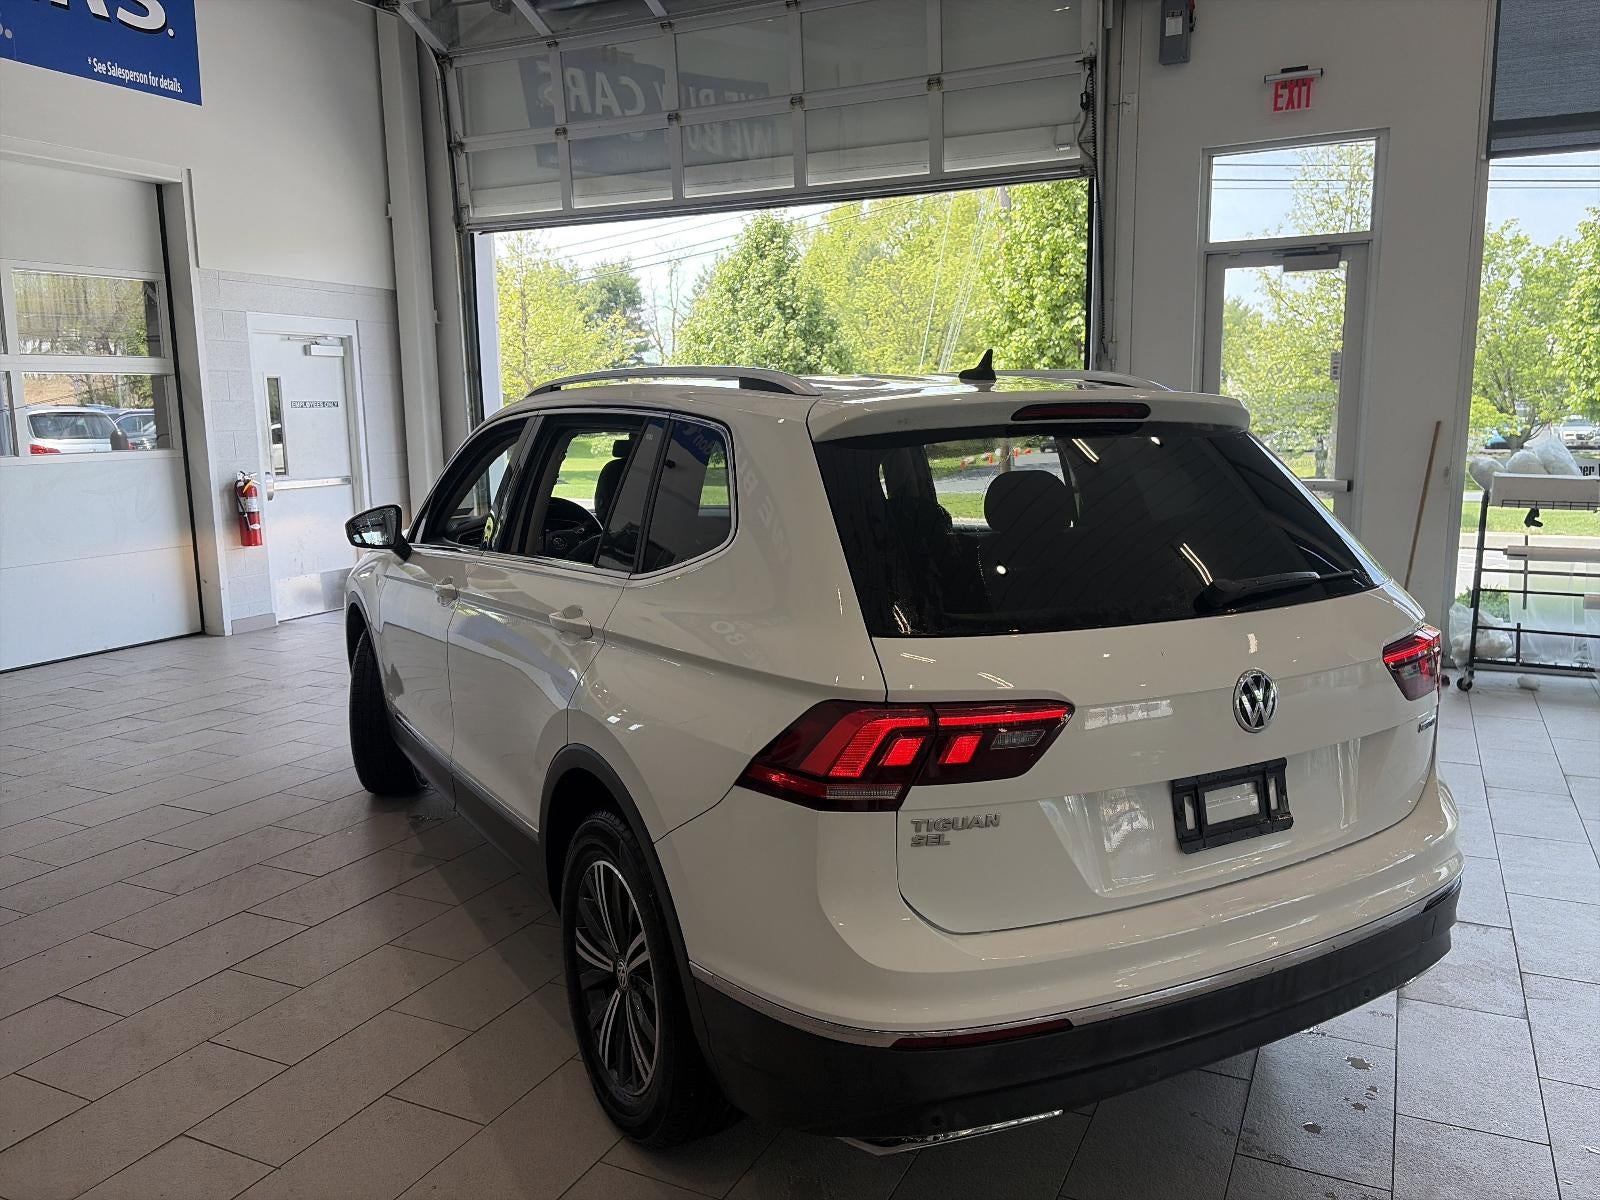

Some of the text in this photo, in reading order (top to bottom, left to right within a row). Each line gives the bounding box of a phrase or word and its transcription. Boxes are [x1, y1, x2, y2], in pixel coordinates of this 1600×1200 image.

[93, 57, 183, 94] See Salesperson for details.
[1273, 77, 1315, 112] EXIT
[910, 813, 1001, 833] TIGUAN
[910, 833, 951, 848] SEL
